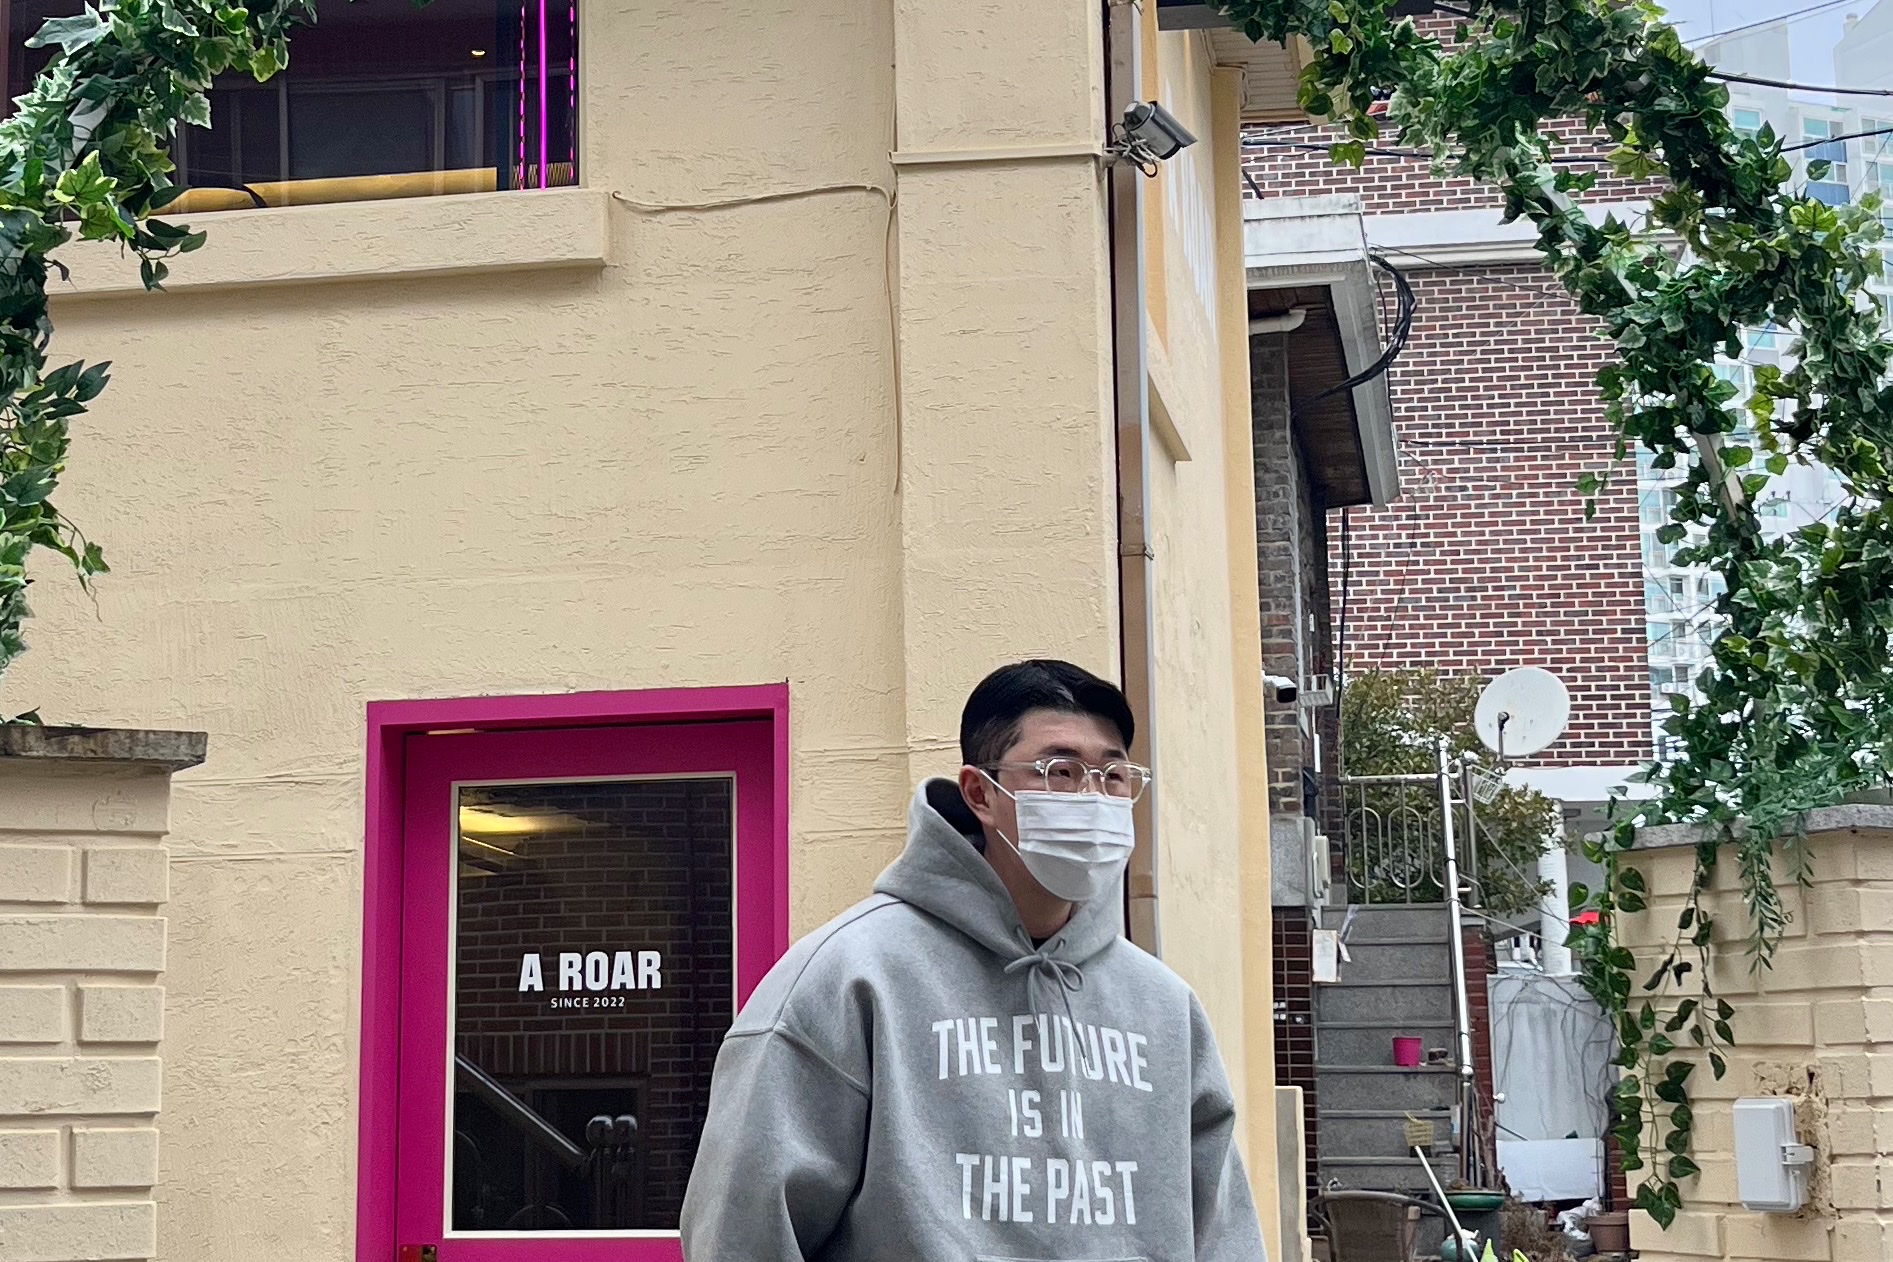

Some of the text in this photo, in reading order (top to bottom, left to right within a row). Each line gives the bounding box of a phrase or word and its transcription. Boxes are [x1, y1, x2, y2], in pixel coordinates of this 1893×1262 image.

[518, 951, 662, 992] A ROAR
[550, 996, 626, 1009] SINCE 2022
[931, 1017, 1002, 1080] THE
[1008, 1088, 1084, 1139] IS IN
[955, 1153, 1139, 1225] THE PAST
